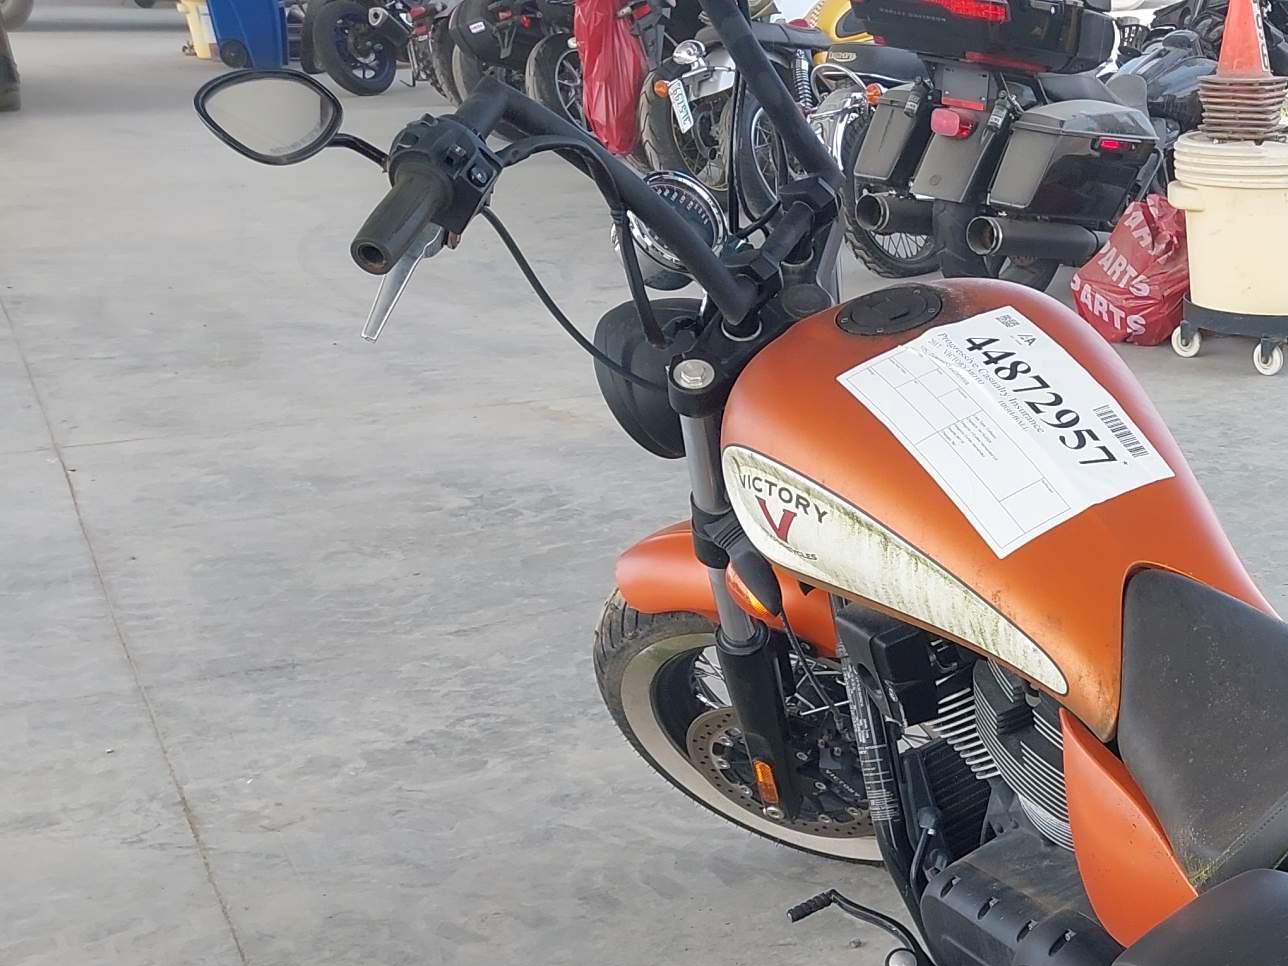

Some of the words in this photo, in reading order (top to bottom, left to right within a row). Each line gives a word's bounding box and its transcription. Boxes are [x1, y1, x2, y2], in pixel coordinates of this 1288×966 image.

[965, 337, 1119, 466] 44872957
[1009, 397, 1045, 432] Insurance
[739, 474, 828, 523] VICTORY
